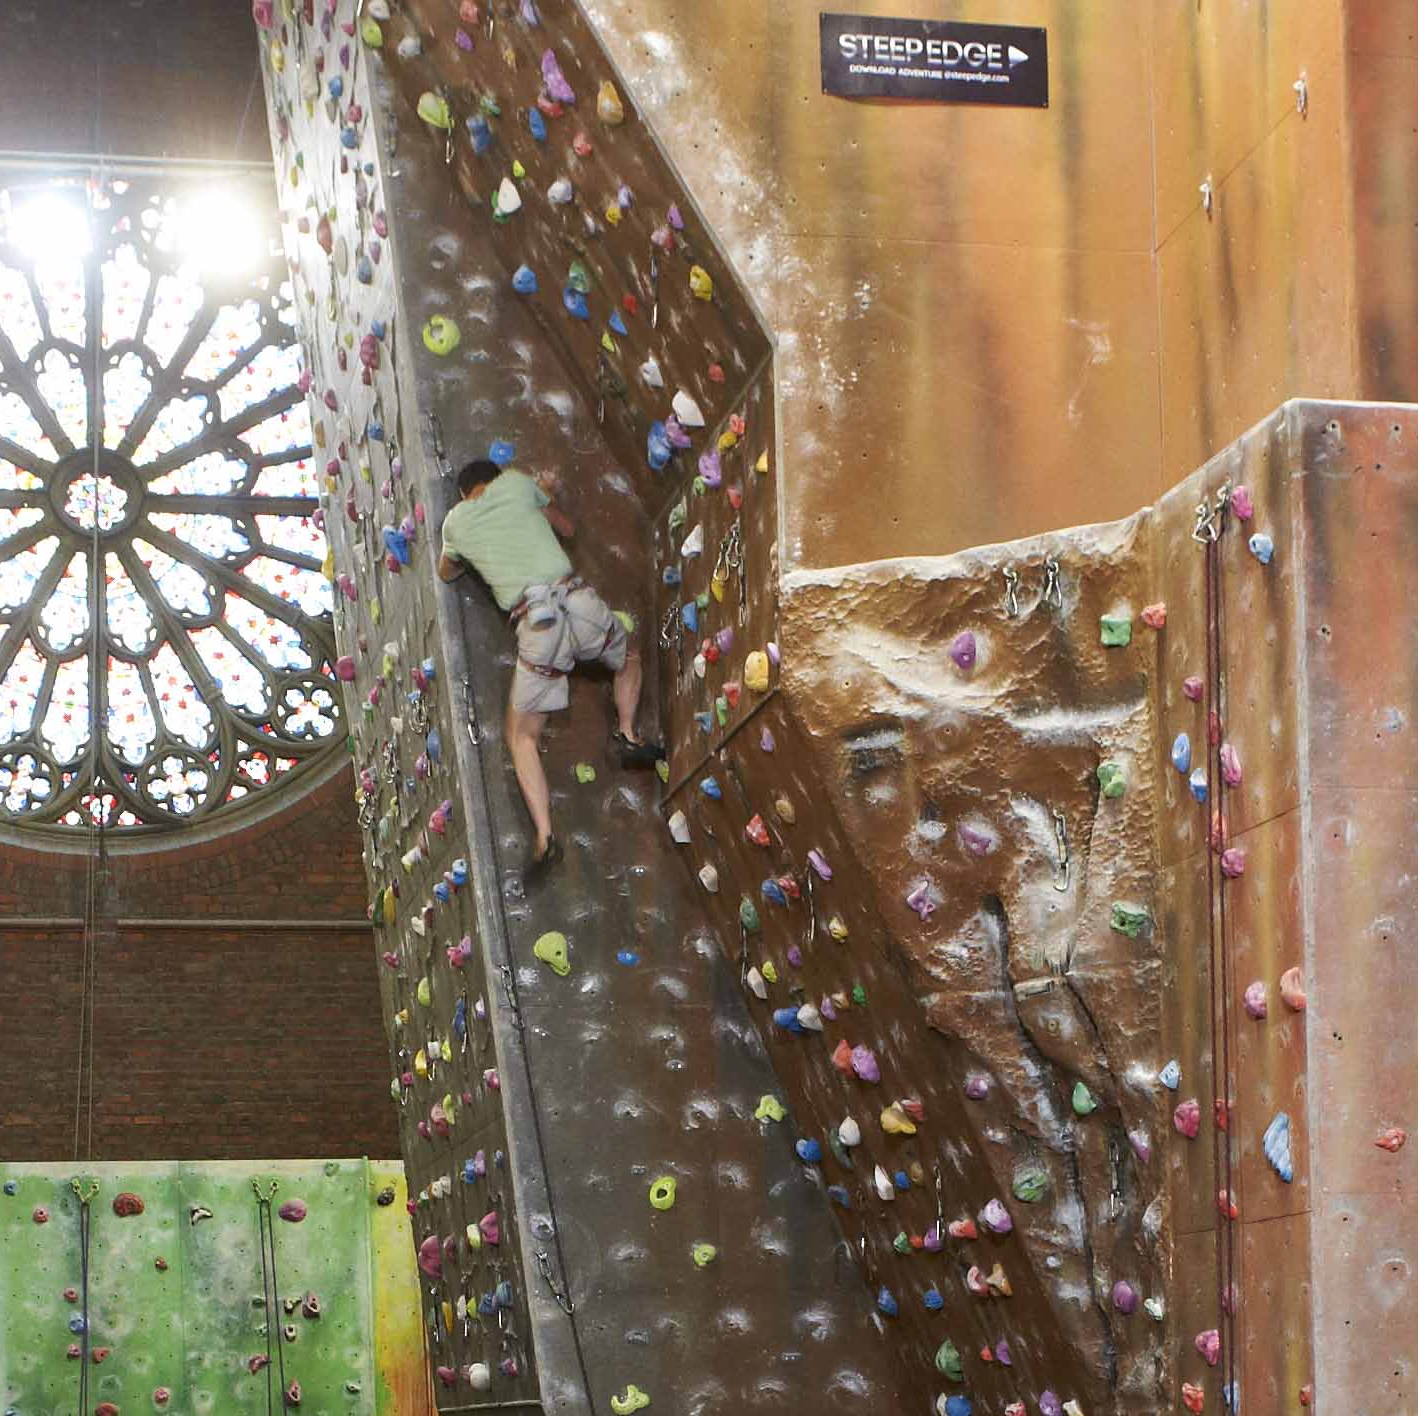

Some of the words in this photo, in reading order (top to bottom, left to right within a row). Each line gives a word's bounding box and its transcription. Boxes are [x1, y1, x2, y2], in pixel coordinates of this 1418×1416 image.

[839, 33, 923, 62] STEEP
[927, 39, 1003, 68] EDGE
[849, 64, 896, 75] DOWNLOAD
[898, 67, 943, 79] ADVENTURE
